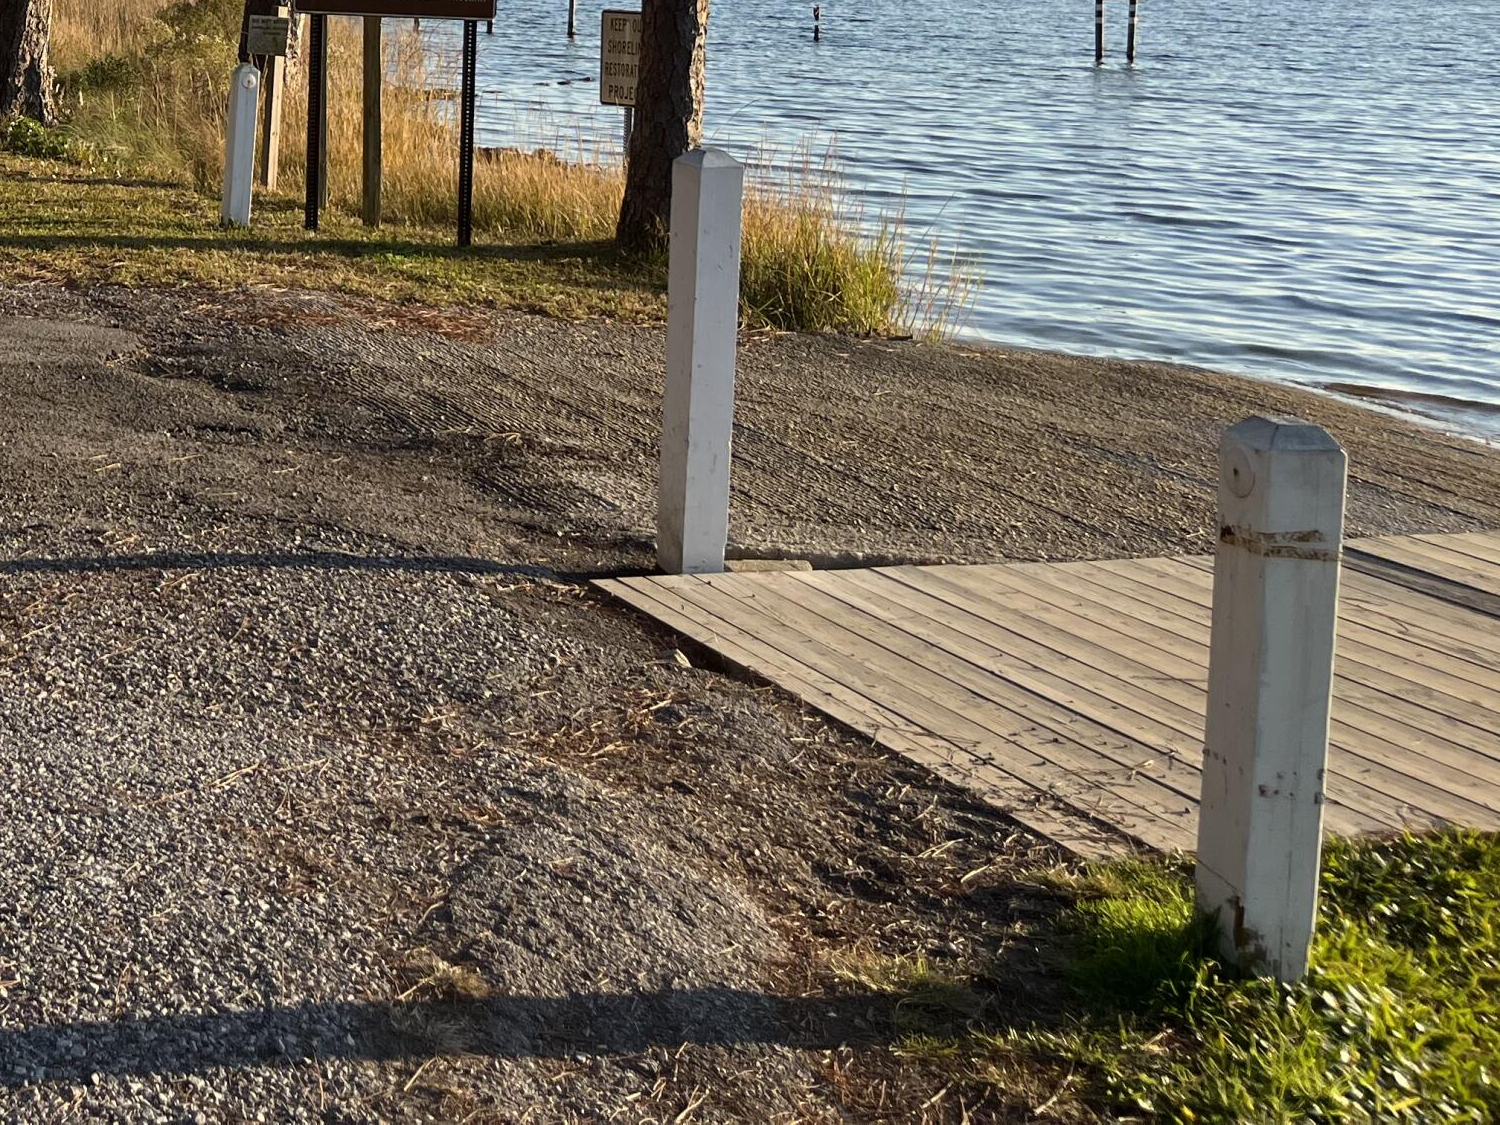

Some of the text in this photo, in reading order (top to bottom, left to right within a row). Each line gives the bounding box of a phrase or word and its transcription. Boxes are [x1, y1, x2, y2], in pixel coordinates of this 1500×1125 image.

[610, 17, 627, 32] KEEP
[607, 40, 642, 56] SHORELIN
[604, 62, 639, 78] RESTORAT
